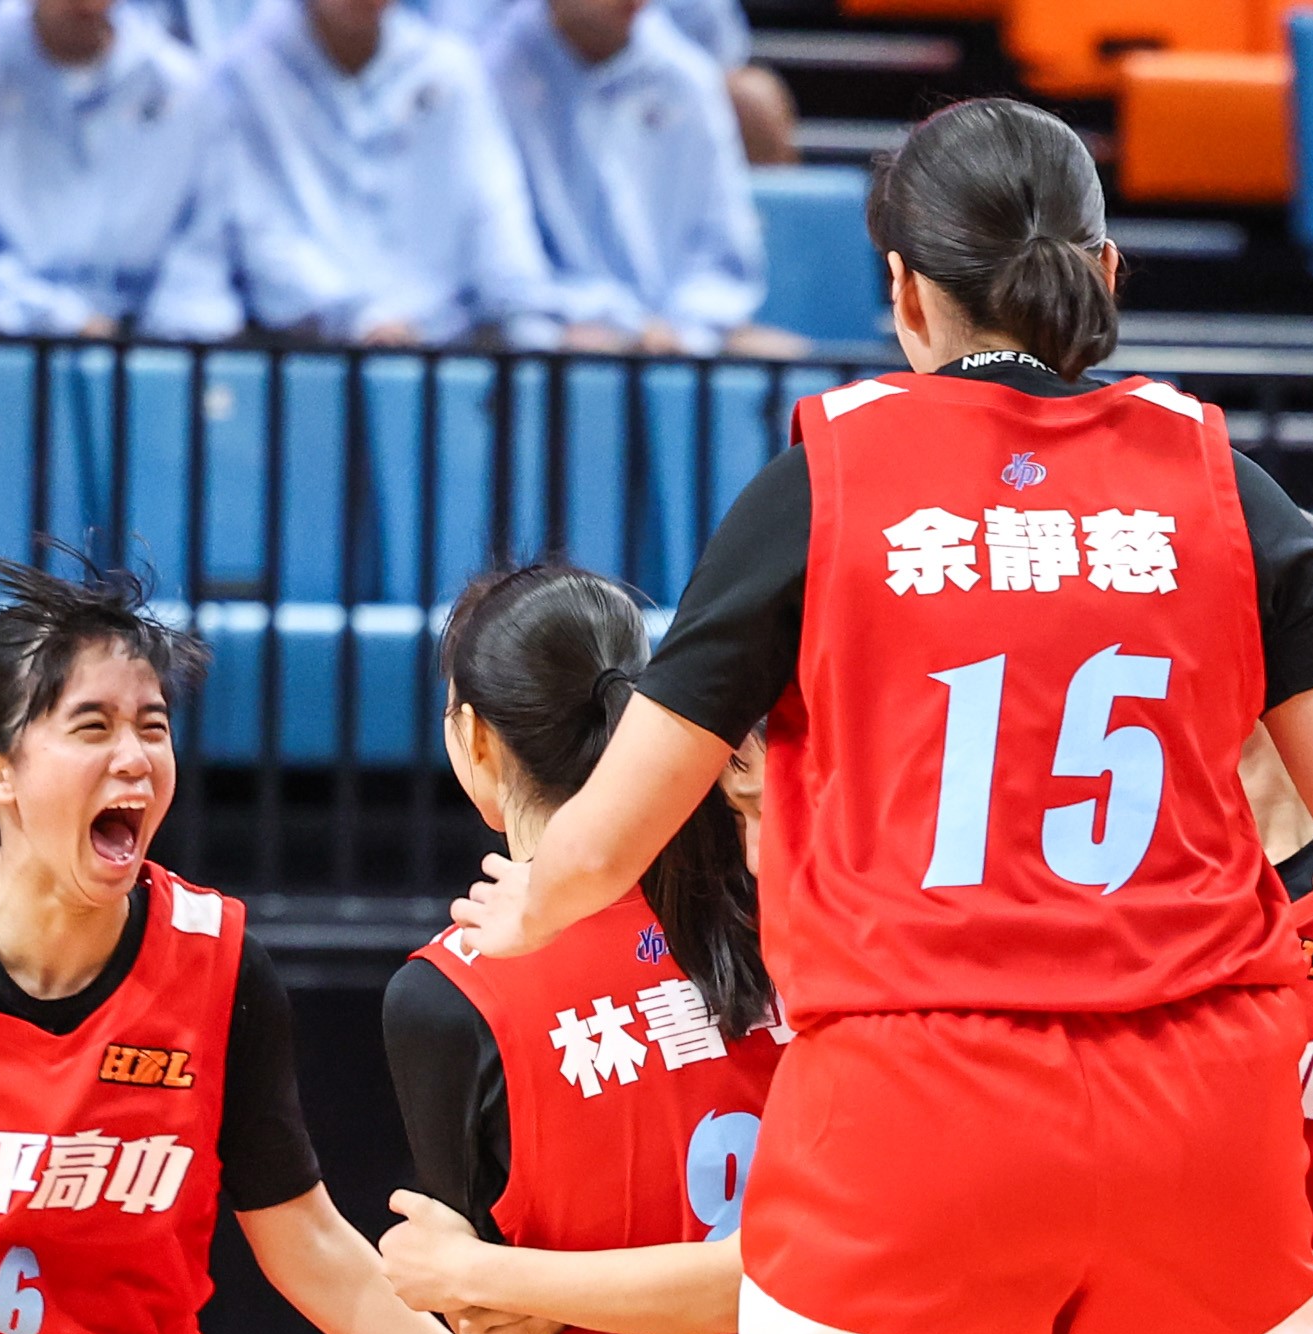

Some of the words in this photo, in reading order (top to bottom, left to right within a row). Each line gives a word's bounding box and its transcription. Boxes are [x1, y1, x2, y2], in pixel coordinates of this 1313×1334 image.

[961, 351, 1017, 370] NIKE
[882, 505, 1178, 597] 余靜慈
[921, 642, 1172, 896] 15
[99, 1043, 194, 1088] HBL
[548, 978, 798, 1099] 林書
